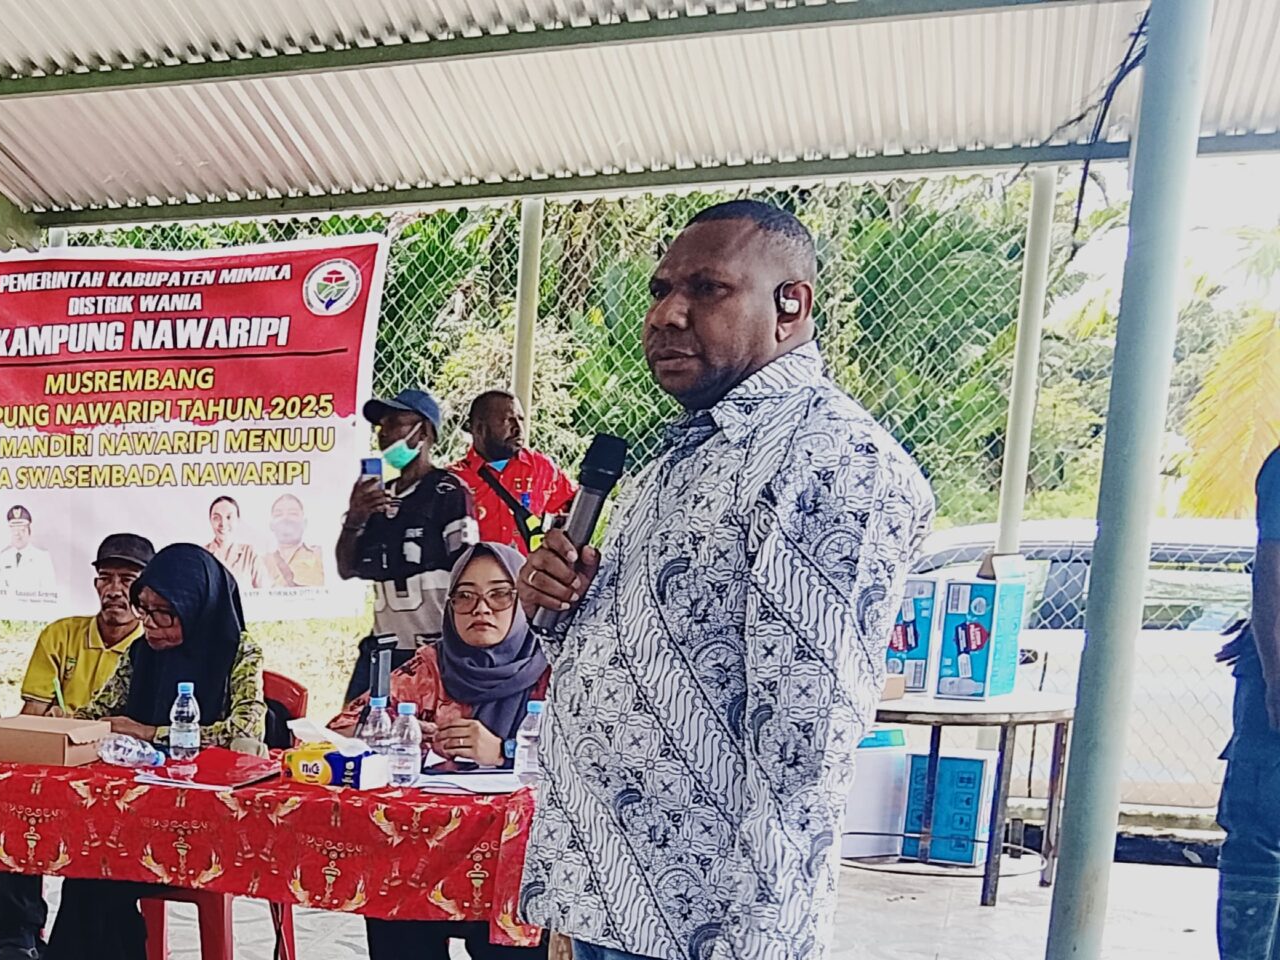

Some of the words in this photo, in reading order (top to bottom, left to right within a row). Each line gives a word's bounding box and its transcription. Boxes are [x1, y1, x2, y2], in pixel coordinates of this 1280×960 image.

[107, 270, 216, 288] KABUPATEN
[218, 264, 291, 284] MIMIKA
[68, 295, 135, 316] DISTRIK
[139, 293, 202, 312] WANIA
[131, 316, 290, 350] NAWARIPI
[44, 368, 214, 395] MUSREMBANG
[55, 400, 171, 425] NAWARIPI
[177, 397, 264, 422] TAHUN
[269, 394, 334, 420] 2025
[99, 431, 219, 456] NAWARIPI
[224, 427, 335, 453] MENUJU
[17, 463, 177, 489] SWASEMBADA
[181, 461, 310, 486] NAWARIPI
